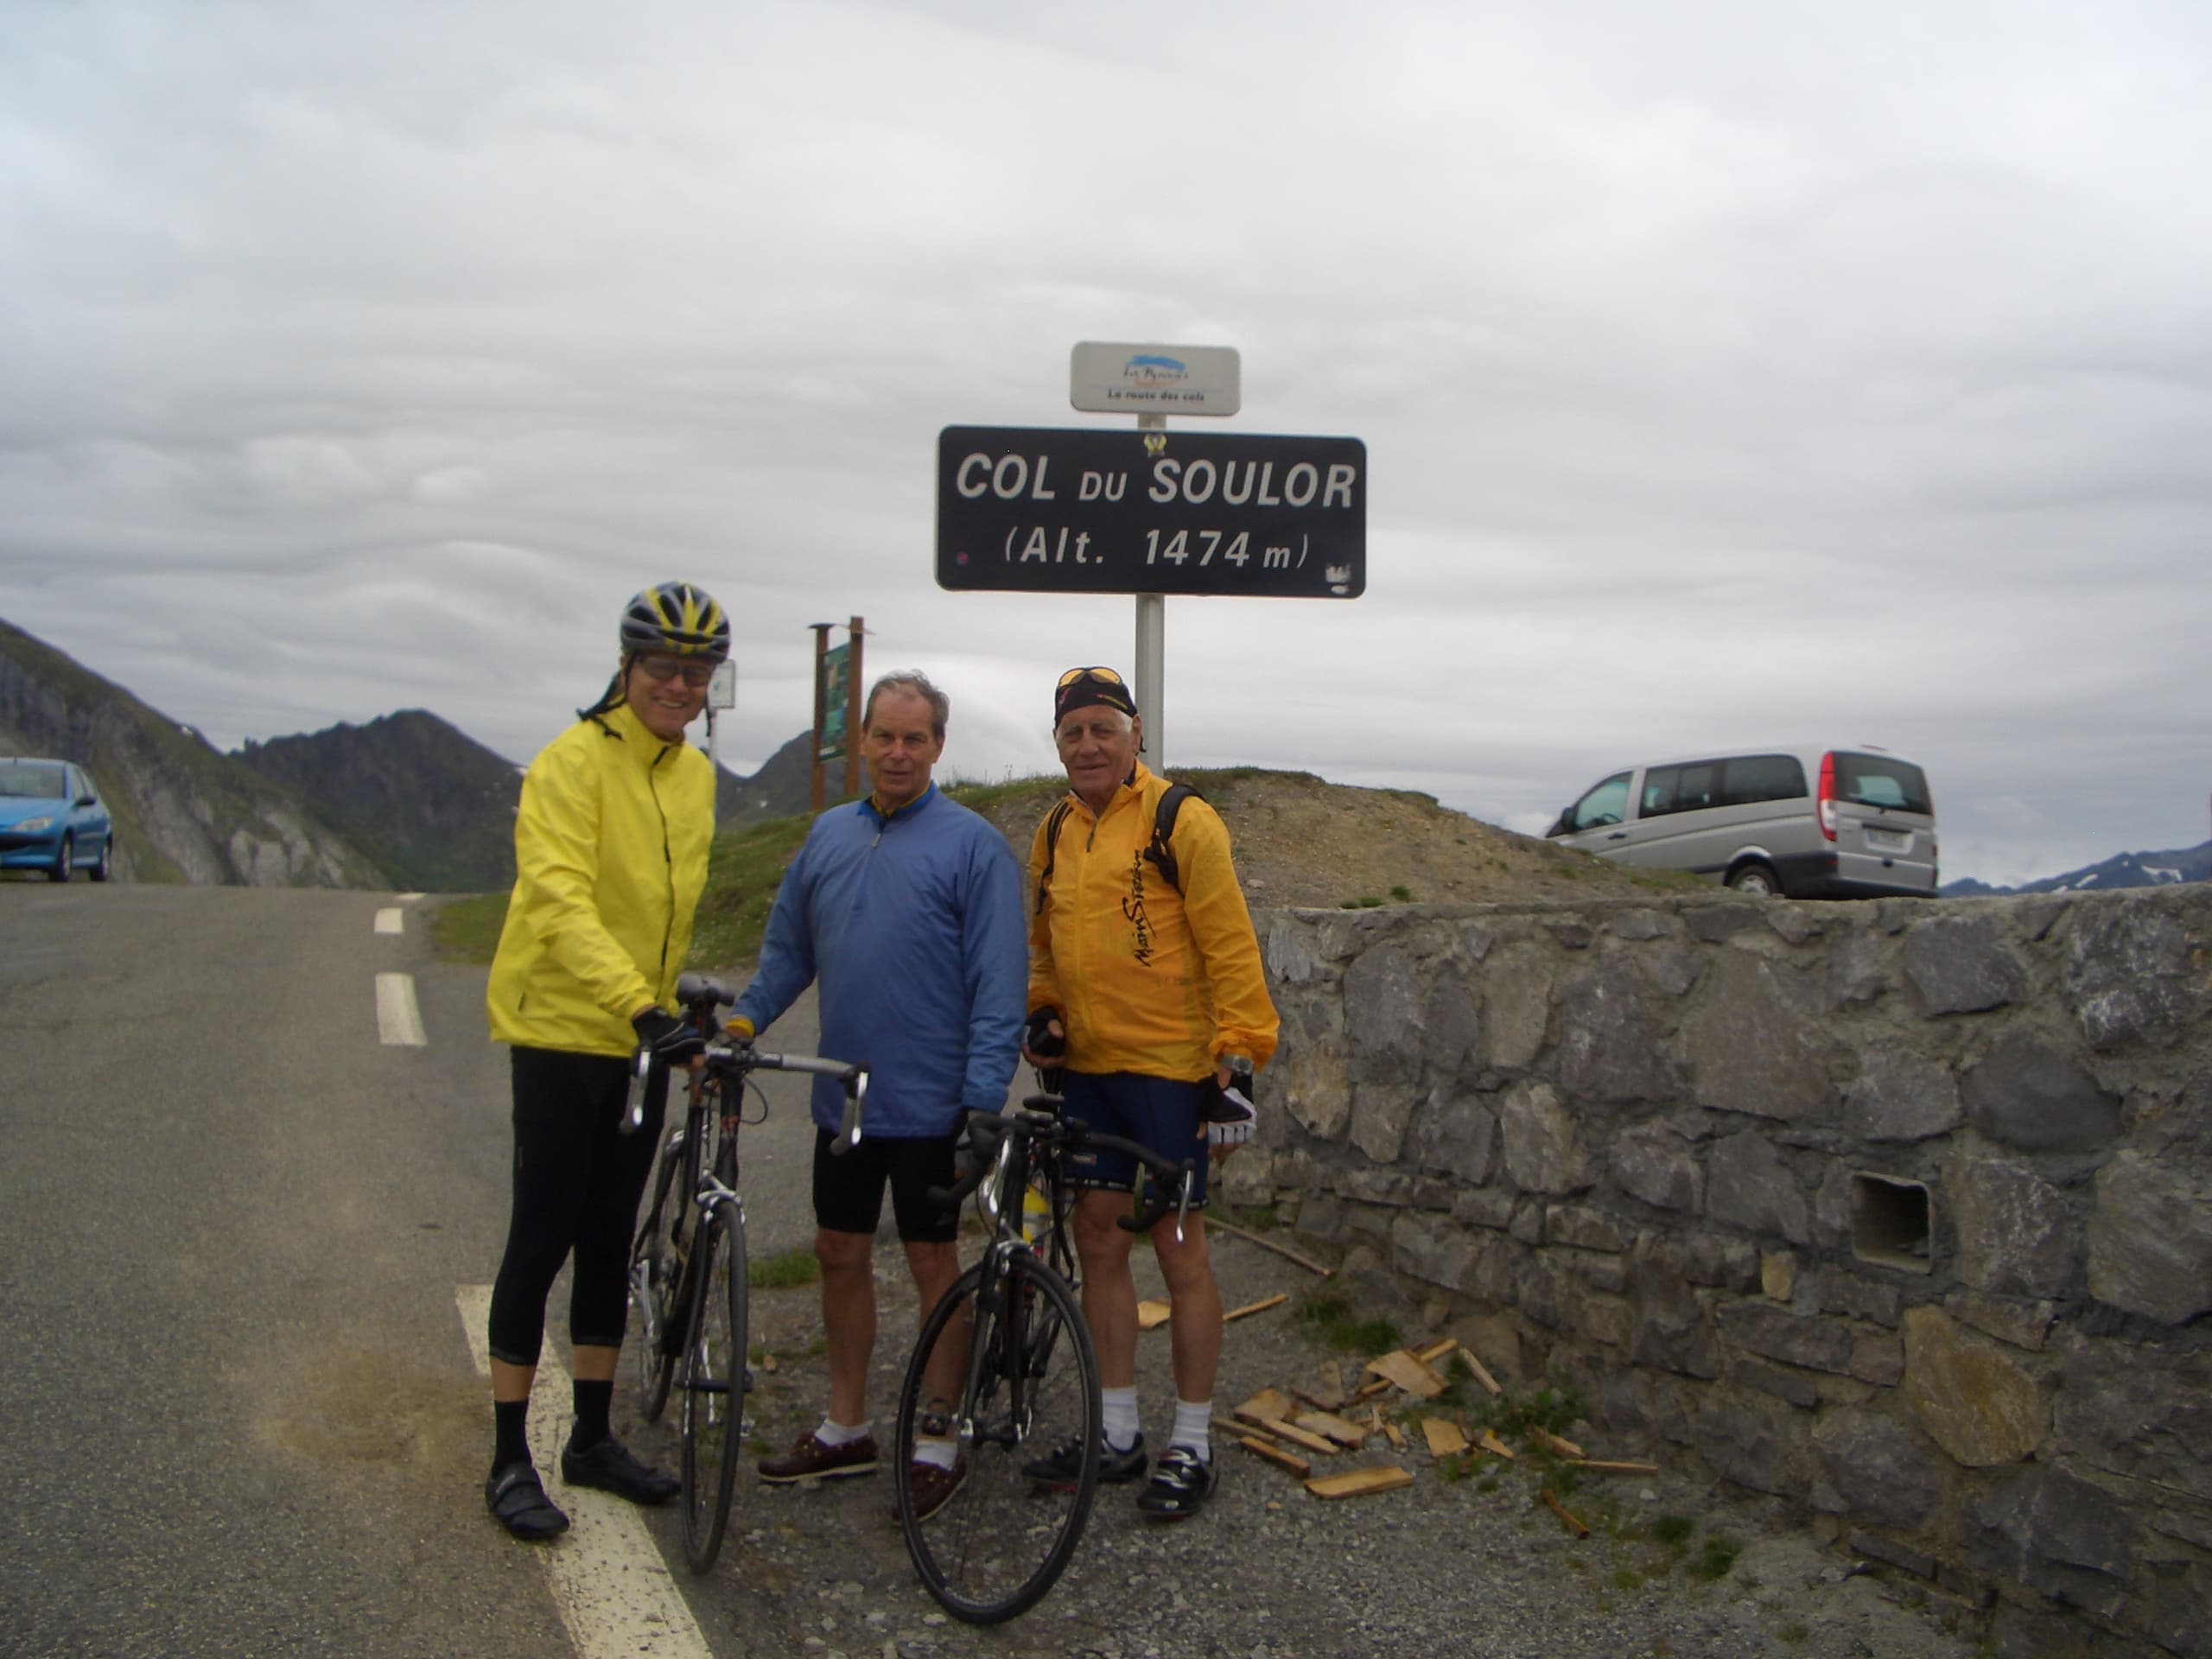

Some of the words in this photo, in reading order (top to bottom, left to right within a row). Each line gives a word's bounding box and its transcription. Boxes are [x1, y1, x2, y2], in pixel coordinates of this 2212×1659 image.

[1126, 391, 1156, 400] route
[1160, 389, 1179, 401] des
[957, 452, 1056, 499] COL
[1078, 471, 1128, 501] DU
[1148, 458, 1356, 508] SOULOR
[1005, 525, 1103, 564] (Alt.
[1147, 529, 1250, 567] 1474
[1262, 533, 1309, 569] m)
